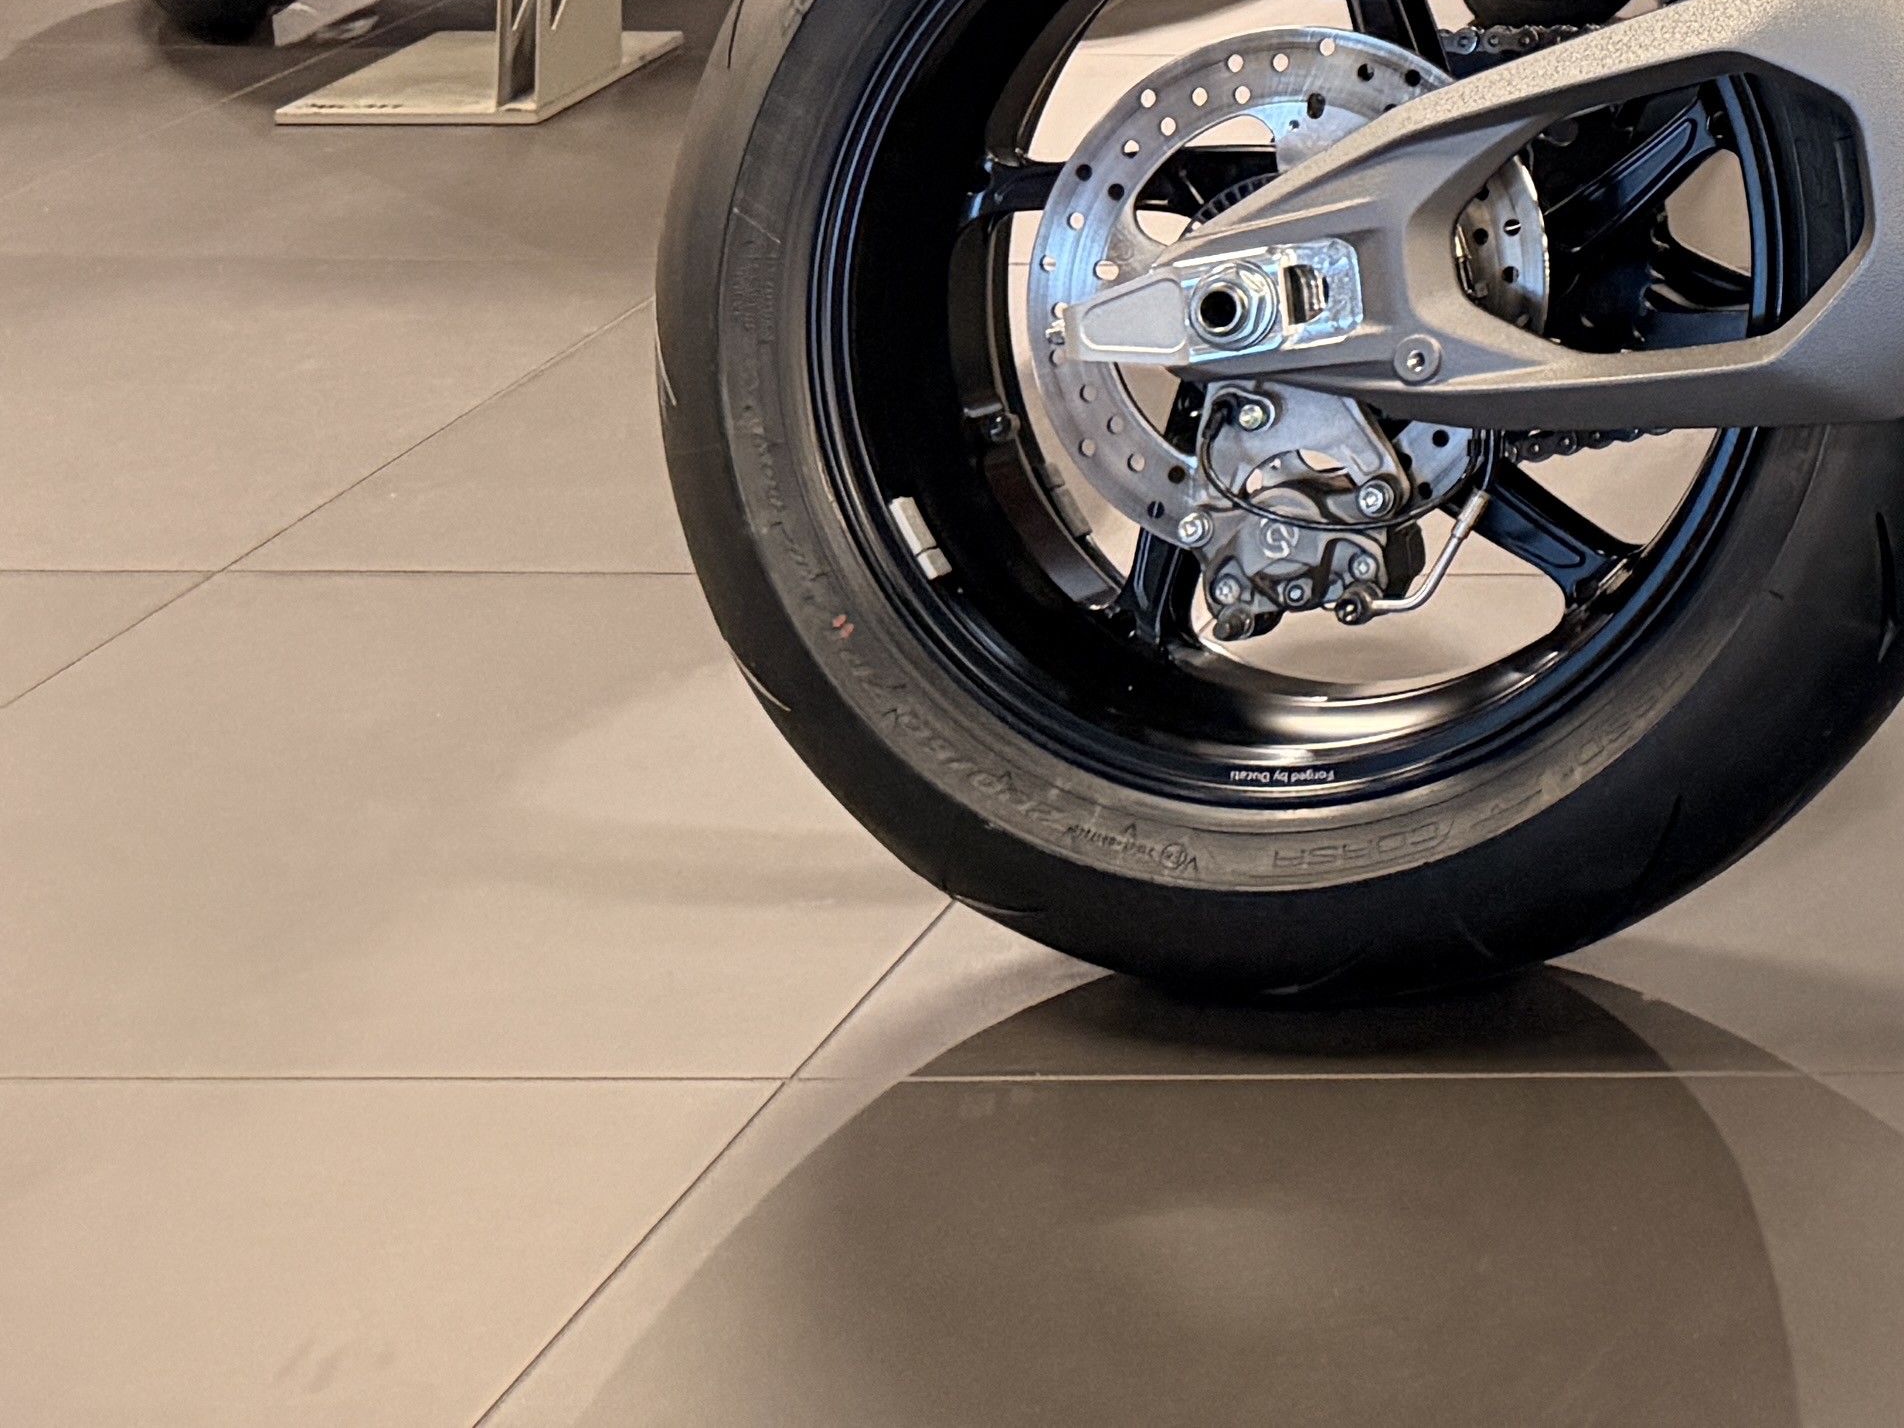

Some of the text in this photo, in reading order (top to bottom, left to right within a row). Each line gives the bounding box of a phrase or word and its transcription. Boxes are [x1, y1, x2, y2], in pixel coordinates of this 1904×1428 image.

[1229, 768, 1335, 784] Forged by Ducati
